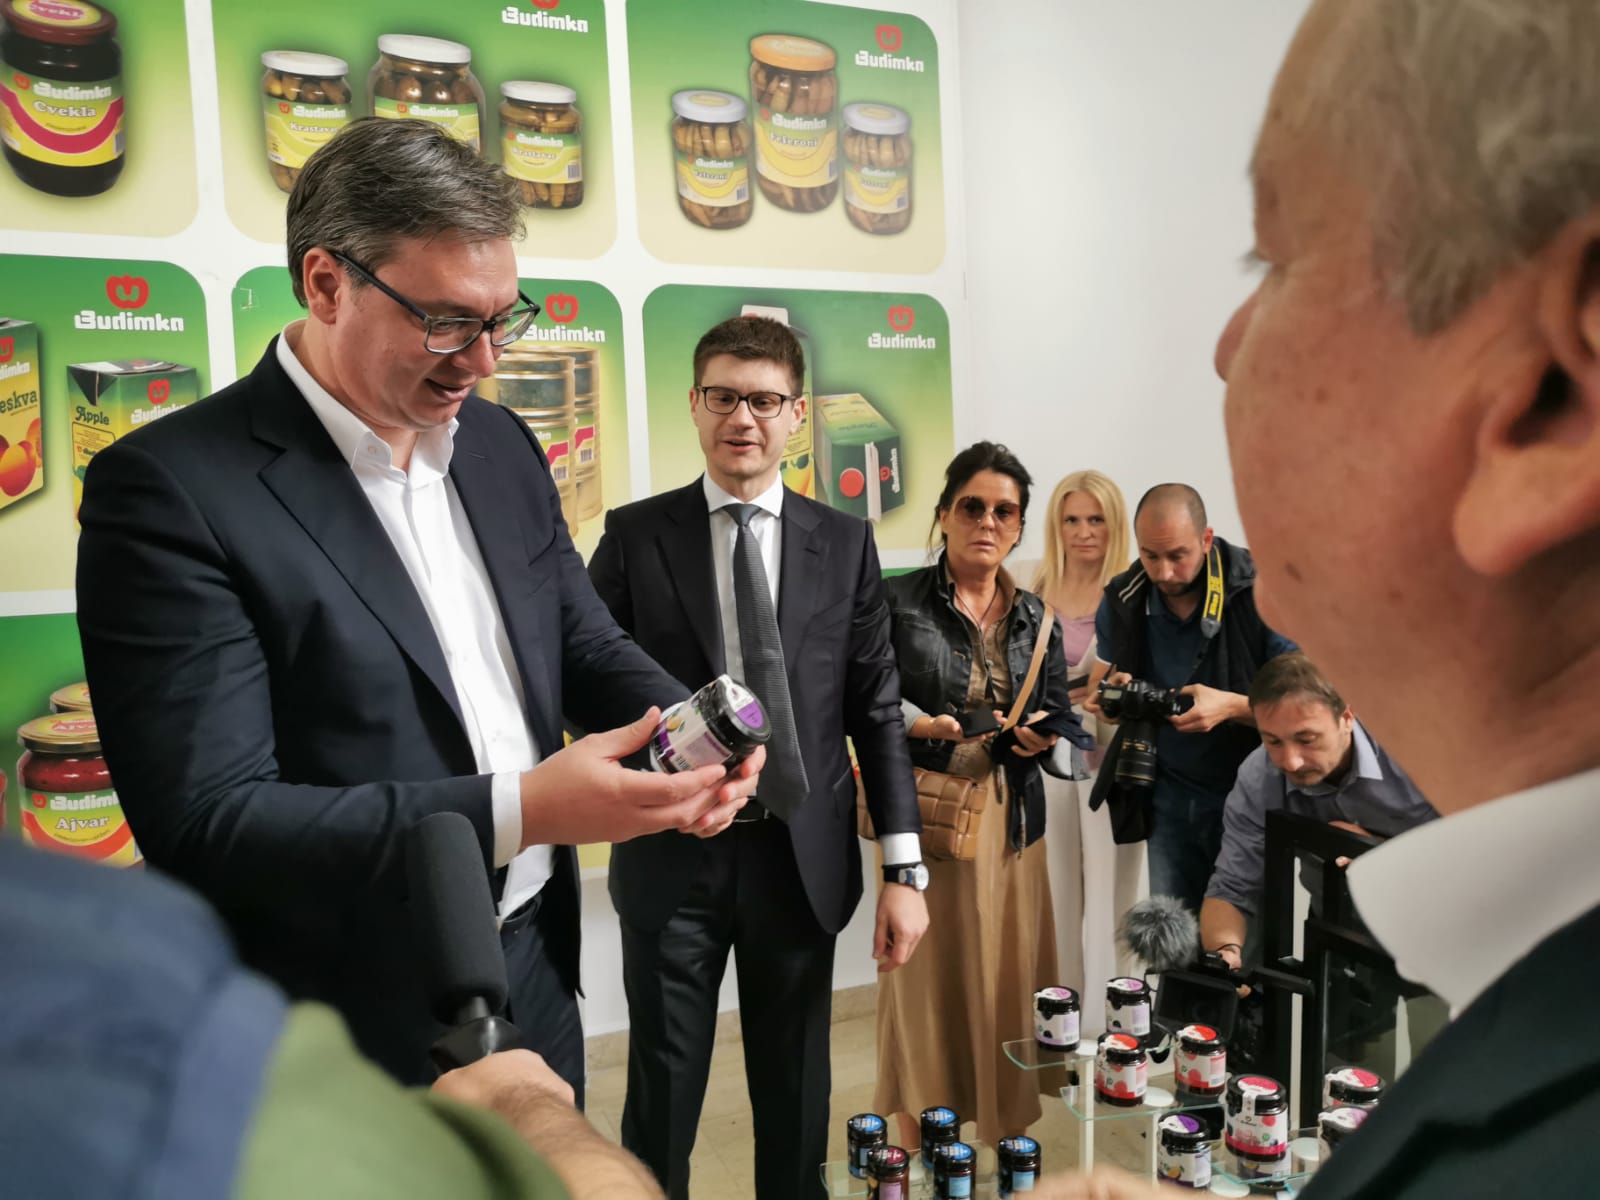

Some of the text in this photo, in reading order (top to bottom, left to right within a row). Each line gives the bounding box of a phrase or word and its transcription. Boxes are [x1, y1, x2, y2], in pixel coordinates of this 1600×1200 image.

[502, 6, 589, 33] Budimka
[855, 50, 924, 72] Budimka
[33, 81, 112, 101] Budimka
[33, 101, 97, 118] Cvekla
[293, 105, 346, 119] Budimka
[772, 112, 827, 129] Budimka
[74, 310, 184, 332] Budimka
[868, 332, 936, 349] Budimka
[75, 406, 110, 425] Apple
[55, 816, 110, 833] Ajvar
